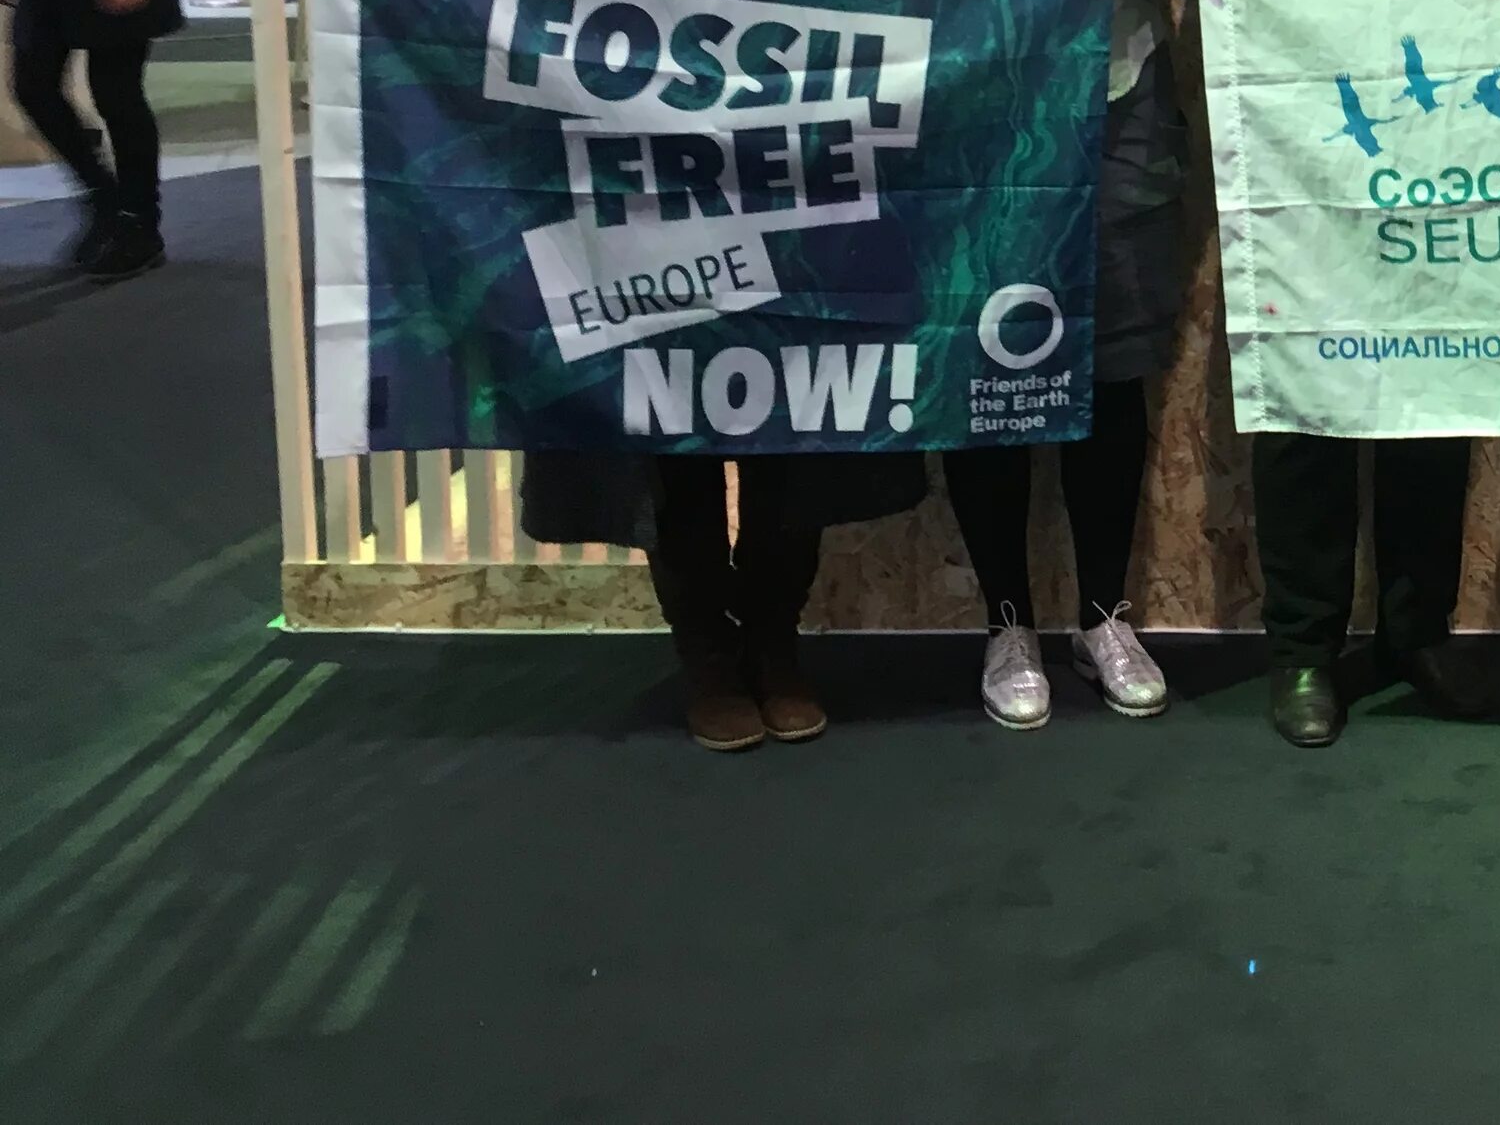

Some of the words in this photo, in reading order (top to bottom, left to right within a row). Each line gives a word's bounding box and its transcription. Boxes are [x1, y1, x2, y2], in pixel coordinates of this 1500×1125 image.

[586, 119, 862, 228] FREE
[566, 243, 756, 335] EUROPE
[622, 343, 919, 437] NOW!
[969, 396, 1007, 414] the
[1012, 390, 1070, 412] Earth
[970, 374, 1048, 395] Friends
[1049, 370, 1072, 387] of
[970, 415, 1047, 434] Europe
